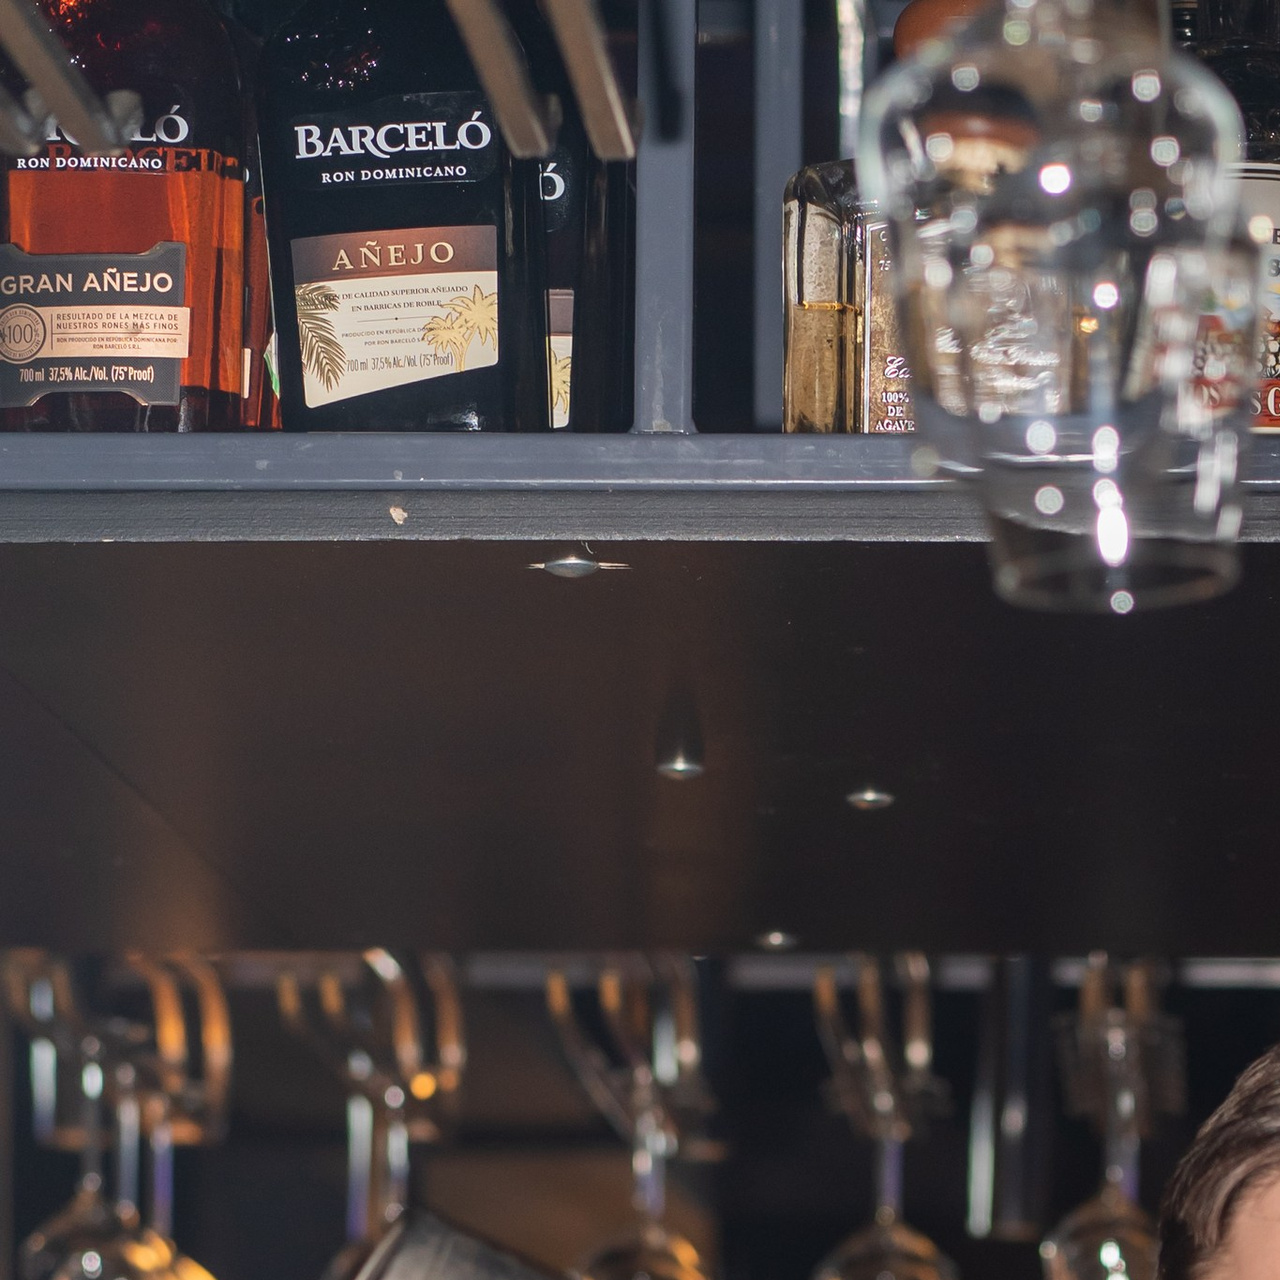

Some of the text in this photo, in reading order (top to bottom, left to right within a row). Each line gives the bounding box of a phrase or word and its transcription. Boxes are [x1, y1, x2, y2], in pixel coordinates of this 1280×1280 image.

[294, 111, 491, 159] BARCELÓ
[16, 157, 162, 169] RON DOMINICANO
[321, 165, 467, 184] RON DOMINICANO
[332, 240, 455, 271] AÑEJO
[1, 268, 173, 295] GRAN AÑEJO
[354, 290, 390, 299] CALIDAD
[391, 288, 430, 297] SUPERIOR
[431, 285, 468, 295] AÑEJADO
[351, 305, 363, 313] EN
[364, 302, 402, 312] BARRICAS
[56, 312, 178, 322] RESULTADO DE LA MEZCLA DE
[56, 320, 178, 331] NUESTROS RONES MÁS FINOS
[8, 324, 33, 344] 100
[49, 367, 72, 382] 37,5%
[74, 365, 108, 383] Alc./Vol.
[128, 365, 154, 383] Proof)
[882, 392, 909, 403] 100%
[887, 405, 903, 417] DE
[875, 419, 915, 431] AGAVE
